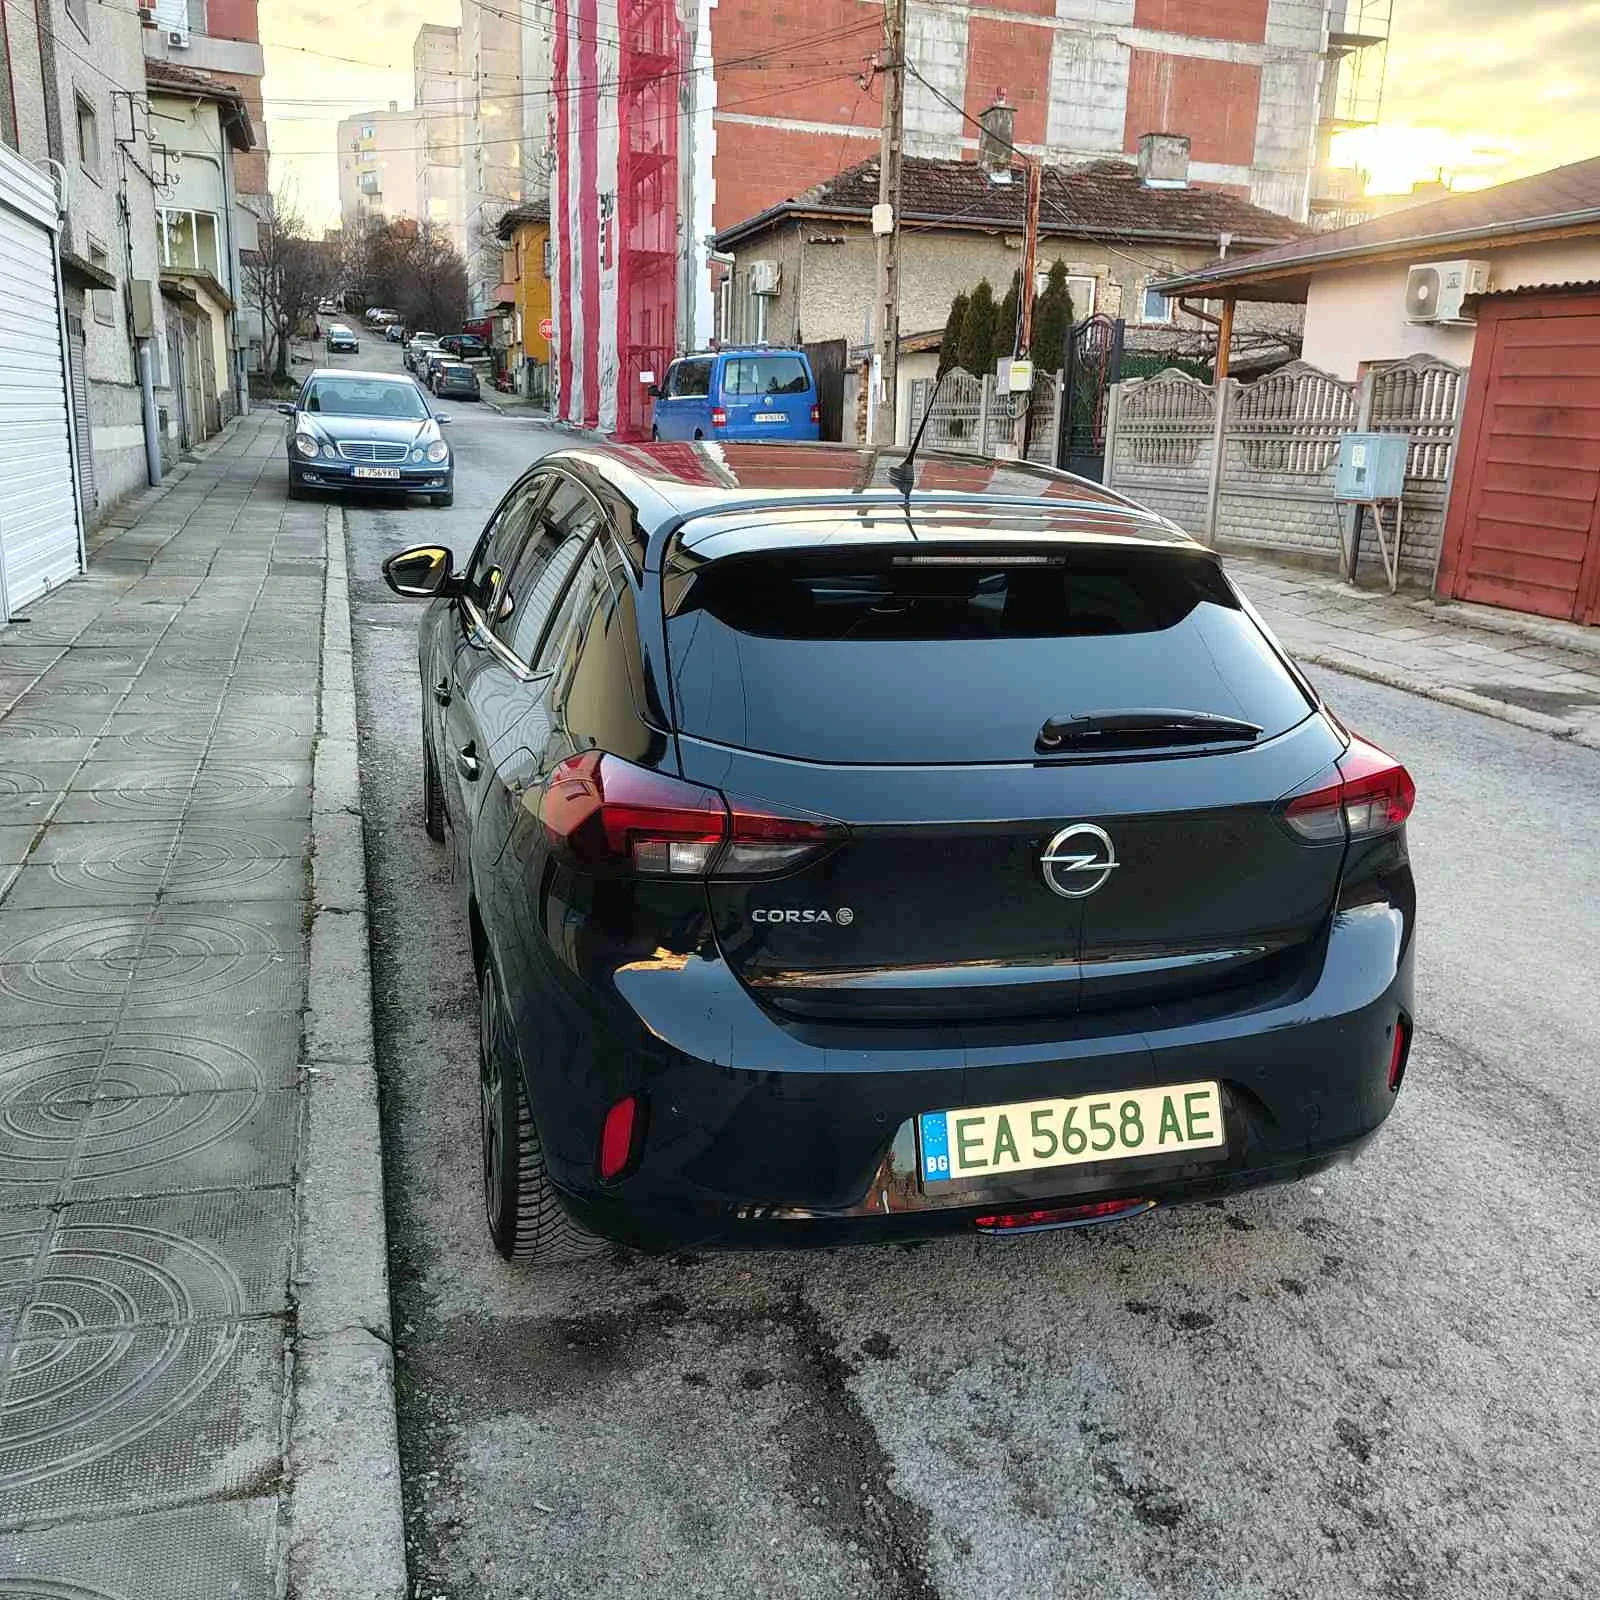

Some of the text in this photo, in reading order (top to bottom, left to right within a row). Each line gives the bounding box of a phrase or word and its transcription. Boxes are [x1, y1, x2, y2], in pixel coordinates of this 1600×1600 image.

[752, 909, 832, 922] CORSA
[956, 1091, 1214, 1169] EA 5658 AE
[926, 1156, 948, 1172] BG
